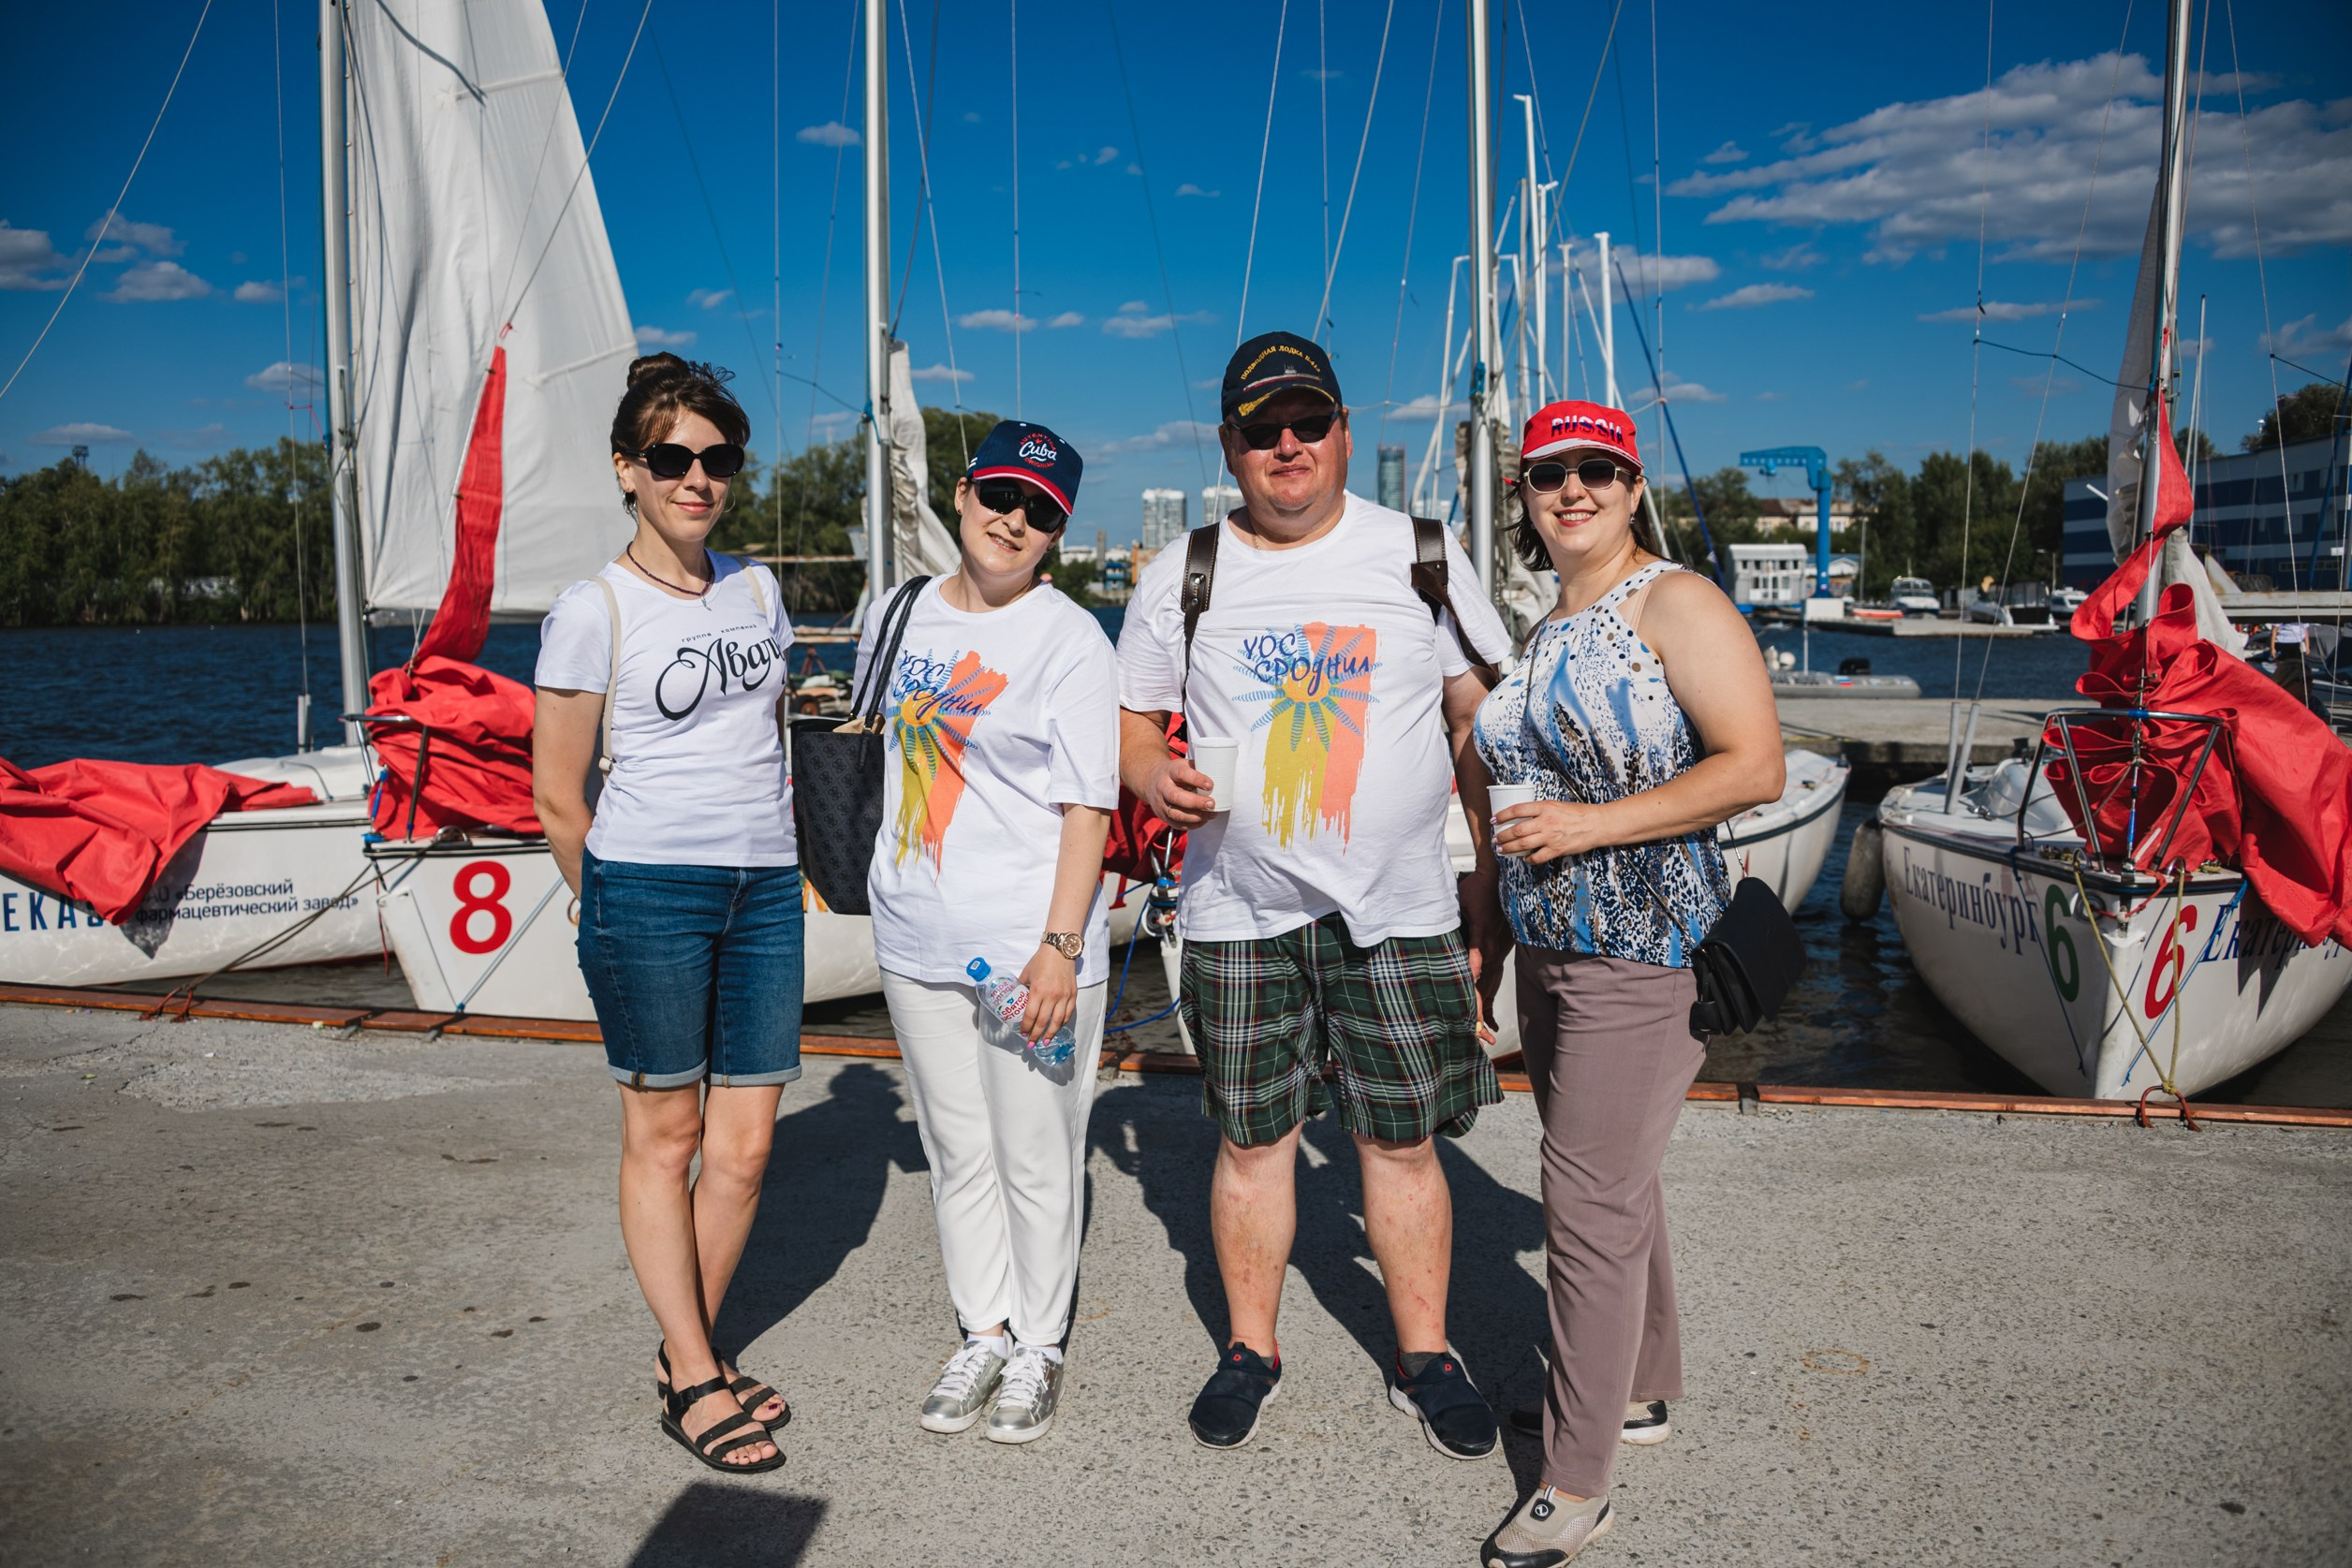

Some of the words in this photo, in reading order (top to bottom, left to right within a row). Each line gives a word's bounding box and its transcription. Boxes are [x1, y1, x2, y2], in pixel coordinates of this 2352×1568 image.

[1240, 345, 1276, 381] ПОДВОДНАЯ
[1278, 344, 1303, 358] ЛОДКА
[1019, 441, 1057, 462] Cuba
[1551, 415, 1625, 447] RUSSIA
[449, 860, 513, 954] 8
[1903, 845, 2038, 956] Екатеринбург
[2044, 884, 2080, 1003] 6
[2144, 904, 2198, 1019] 6
